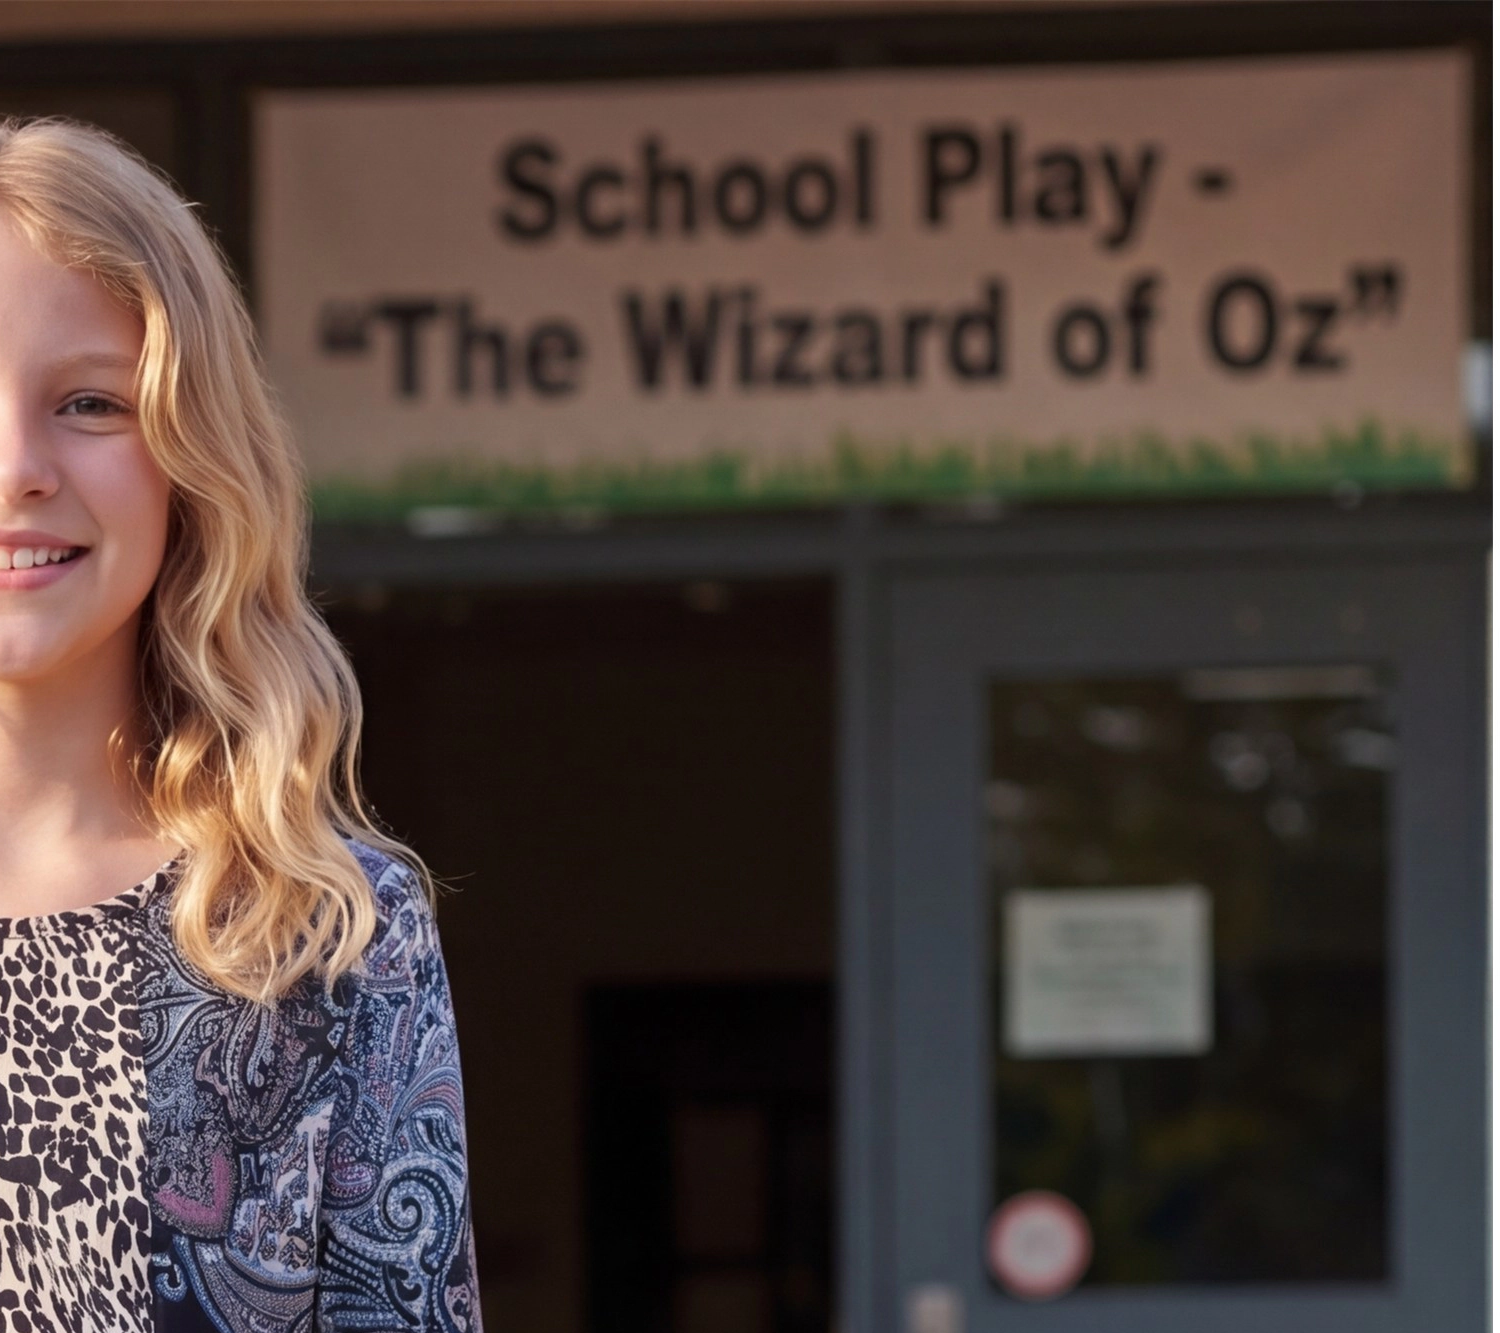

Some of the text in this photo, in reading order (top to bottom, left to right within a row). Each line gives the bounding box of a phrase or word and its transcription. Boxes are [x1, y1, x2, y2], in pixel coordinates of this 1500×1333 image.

[496, 126, 876, 244] School
[916, 124, 1162, 252] Play
[315, 262, 1406, 398] “The Wizard of Oz”
